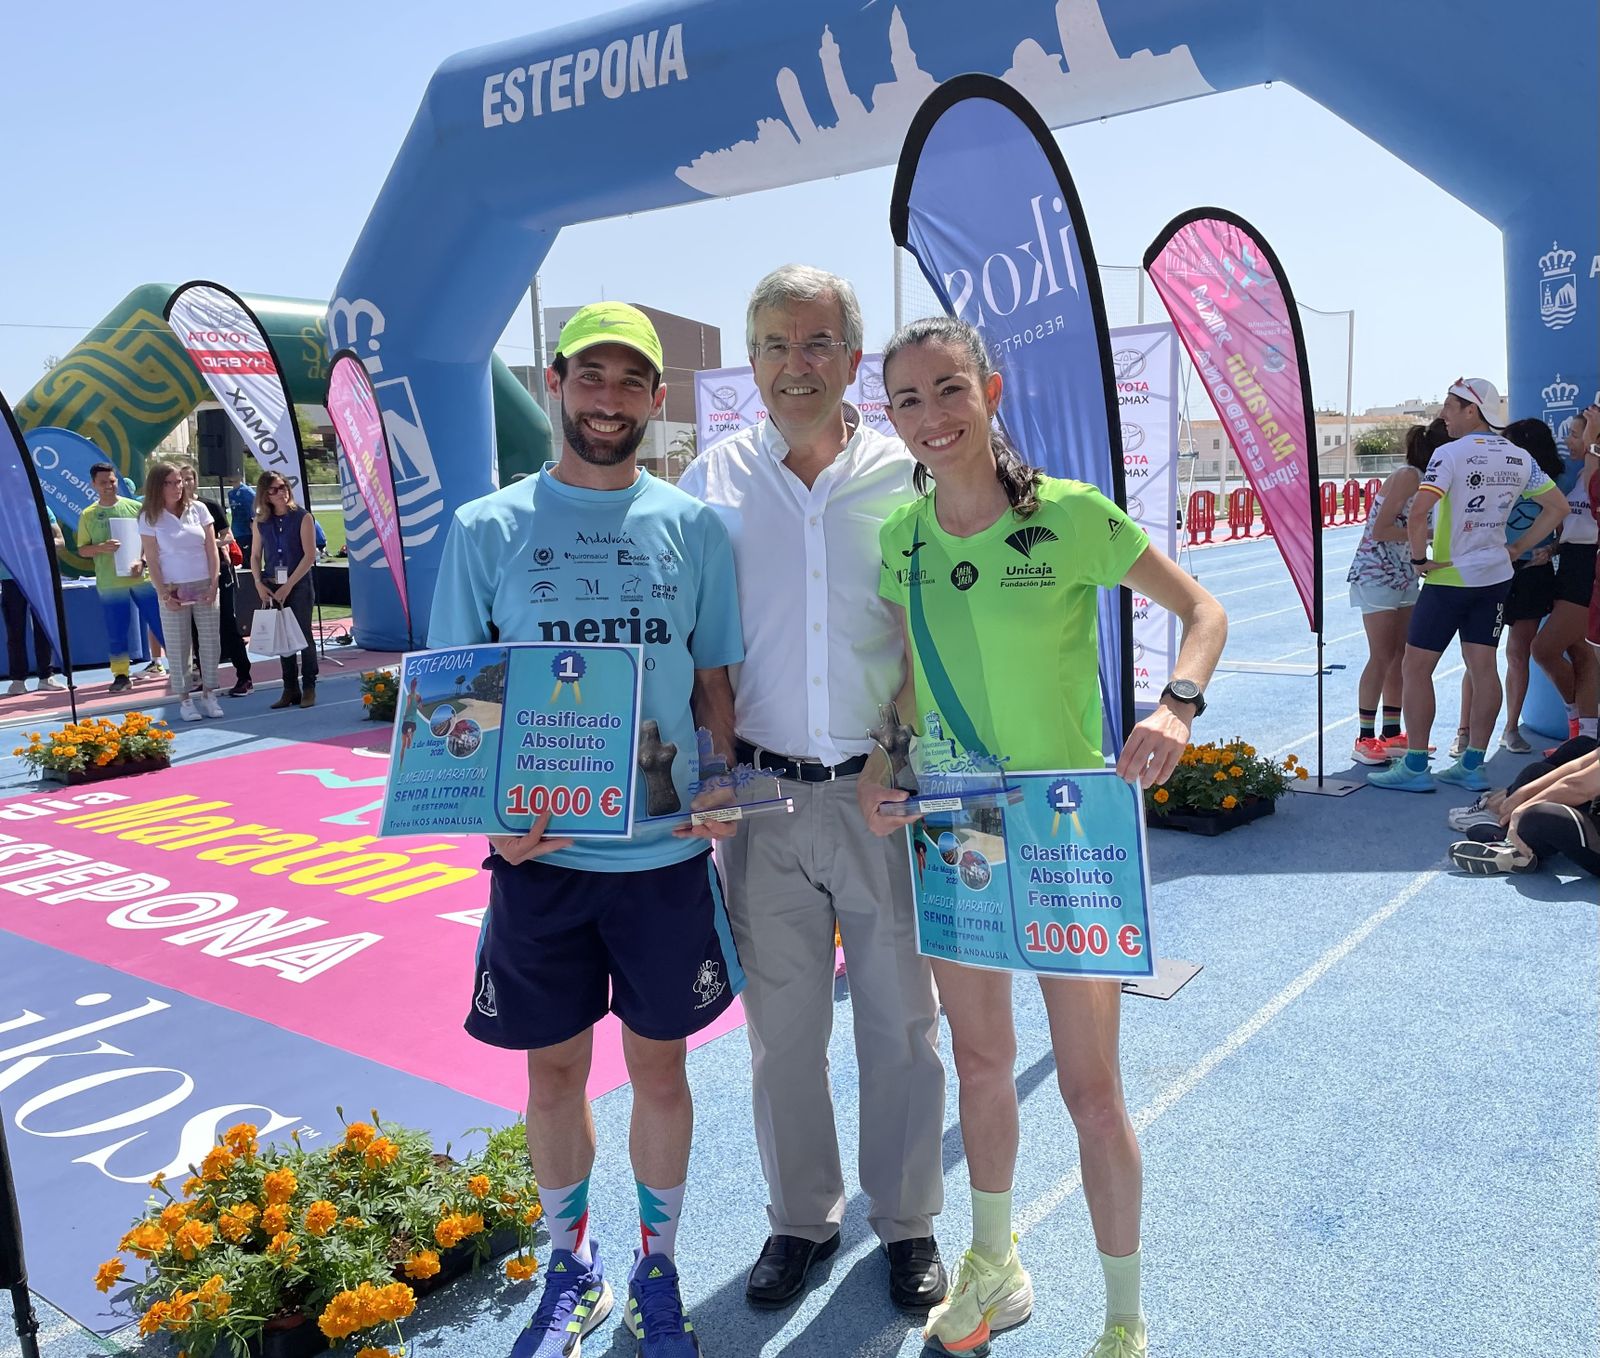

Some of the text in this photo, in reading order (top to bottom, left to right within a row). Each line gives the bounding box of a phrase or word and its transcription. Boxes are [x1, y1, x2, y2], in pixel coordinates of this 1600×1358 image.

[483, 23, 688, 128] ESTEPONA
[1117, 381, 1149, 392] YOTA
[857, 403, 887, 412] TOYO
[1118, 395, 1149, 405] OMAX
[709, 412, 740, 422] TOYOTA
[864, 414, 887, 423] TOMA
[1124, 455, 1149, 464] OTA
[1125, 469, 1149, 478] MAX
[575, 531, 636, 546] Andalucía
[1006, 562, 1053, 577] Unicaja
[1000, 579, 1056, 588] Fundación Jaén
[538, 607, 672, 644] nerja
[408, 652, 474, 676] ESTEPONA
[558, 656, 579, 678] 1
[516, 710, 622, 729] Clasificado
[521, 732, 606, 750] Absoluto
[516, 753, 615, 773] Masculino
[394, 785, 487, 802] SENDA LITORAL
[505, 784, 624, 818] 1000 €
[1055, 784, 1076, 808] 1
[0, 792, 132, 820] dia
[421, 802, 459, 811] ESTEPONA
[411, 818, 430, 827] IKOS
[432, 816, 483, 826] ANDALUSIA
[53, 794, 479, 903] Maratón
[1019, 844, 1127, 862] Clasificado
[1029, 866, 1113, 885] Absoluto
[0, 834, 384, 983] TEPONA
[1027, 890, 1122, 909] Femenino
[924, 910, 1007, 933] SENDA LITORAL
[950, 930, 985, 942] ESTEPONA
[1025, 920, 1143, 958] 1000 €
[945, 946, 963, 954] IKOS
[964, 948, 1009, 960] ANDALUSIA
